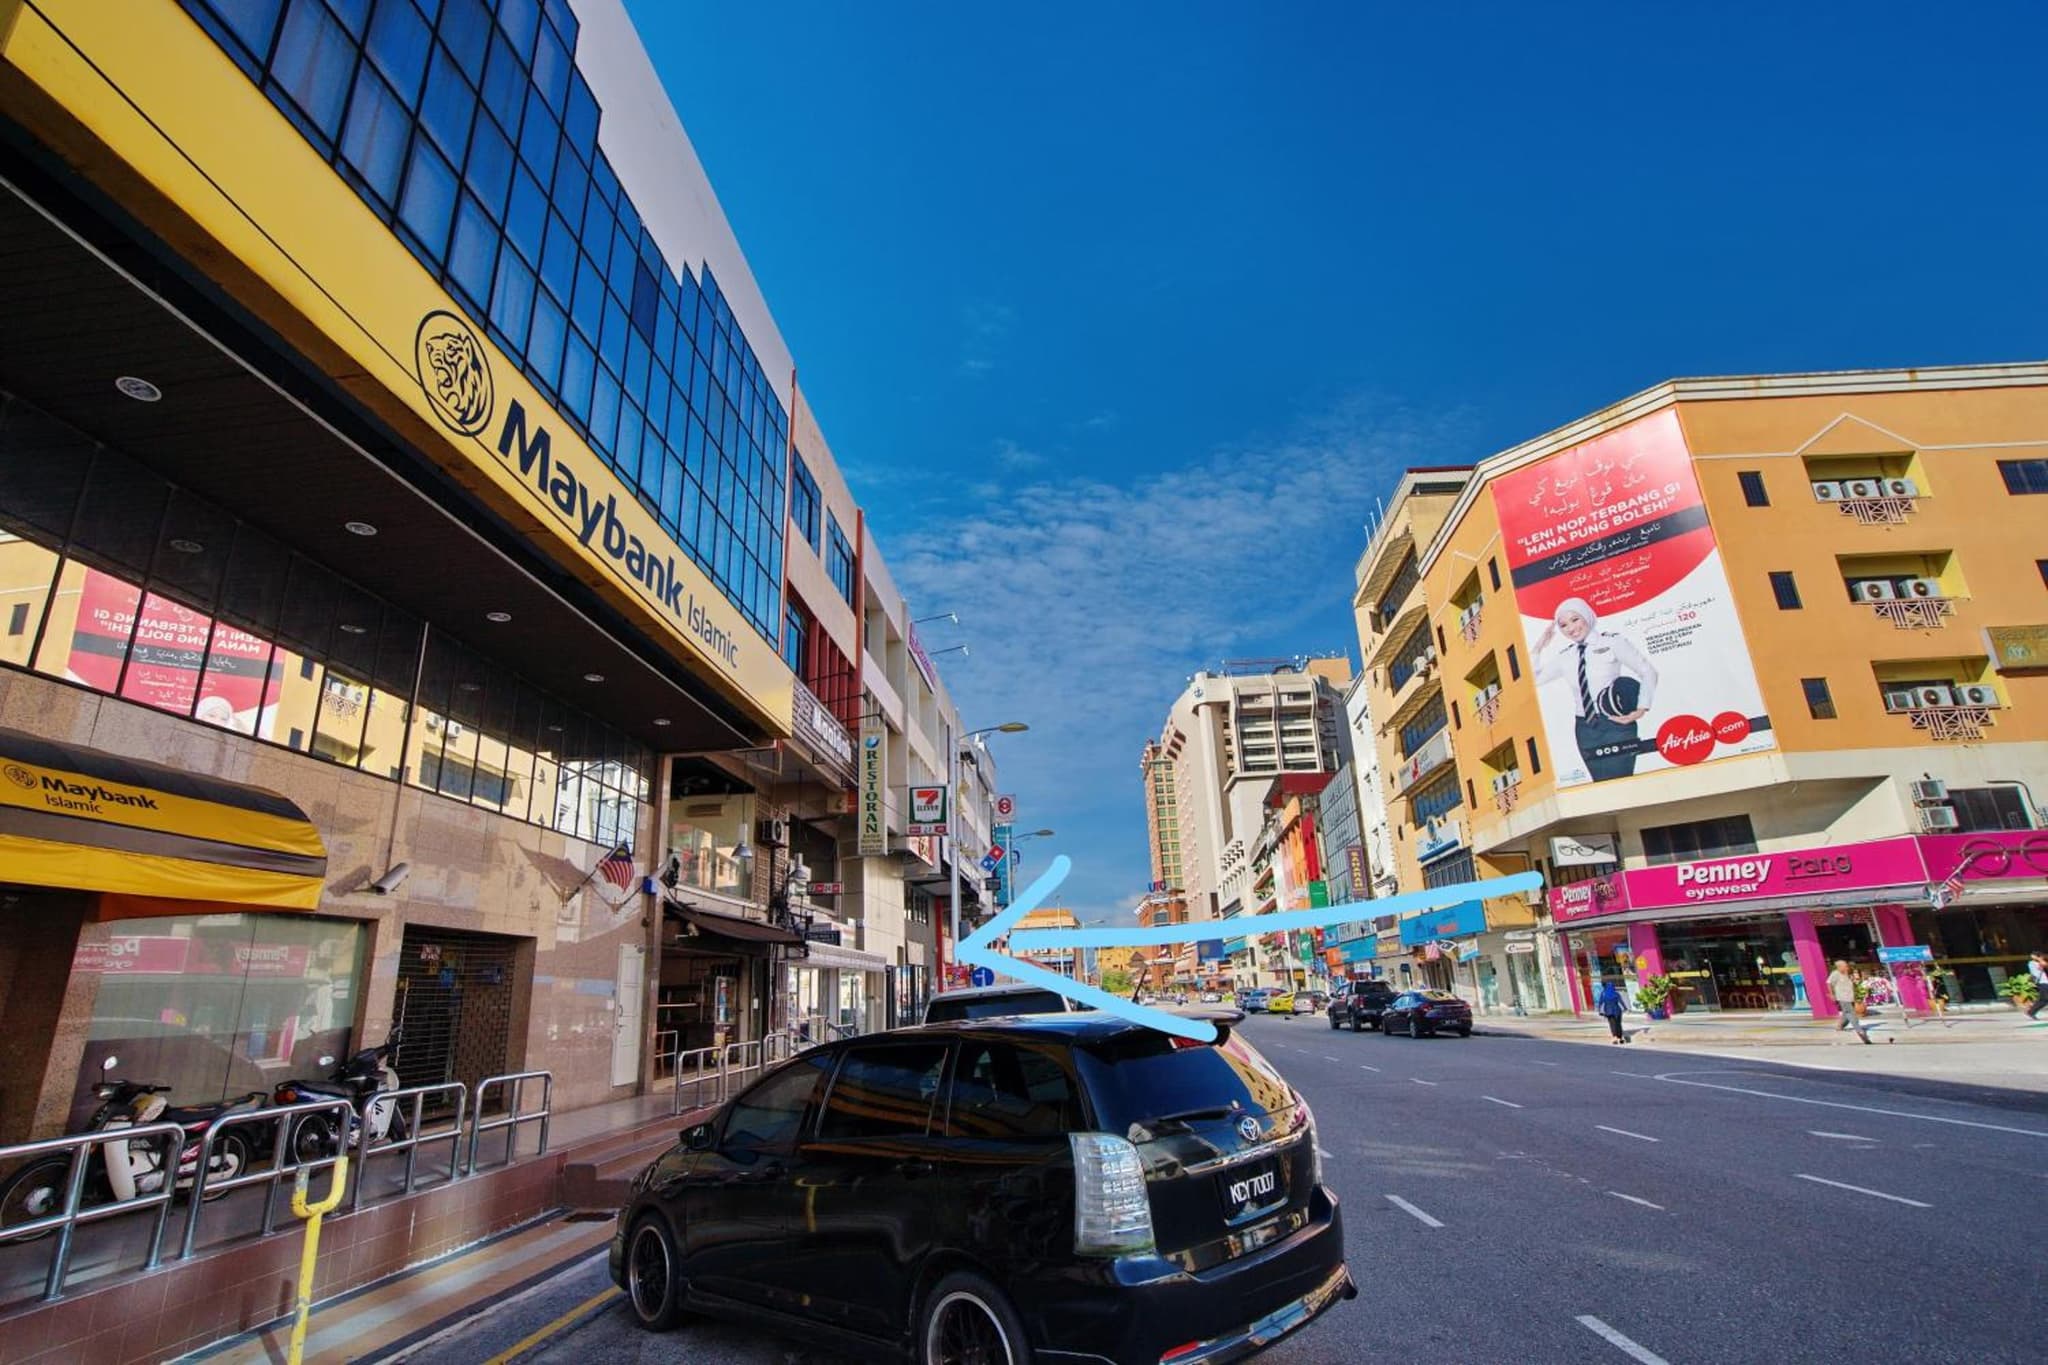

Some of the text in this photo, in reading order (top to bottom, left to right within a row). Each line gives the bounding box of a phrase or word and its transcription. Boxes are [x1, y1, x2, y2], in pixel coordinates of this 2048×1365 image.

[1557, 516, 1587, 534] NOP
[1590, 489, 1661, 522] TERBANG
[1664, 481, 1682, 495] GI
[500, 397, 739, 668] Maybank Islamic
[1526, 538, 1567, 557] MANA
[1569, 520, 1609, 542] PUNG
[1678, 611, 1696, 622] 120
[1662, 729, 1712, 752] AirAsia
[41, 776, 158, 810] Maybank
[45, 794, 103, 814] Islamic
[865, 750, 879, 833] RESTORAN
[1677, 854, 1852, 886] Penney Pang
[1686, 882, 1759, 899] eyewear
